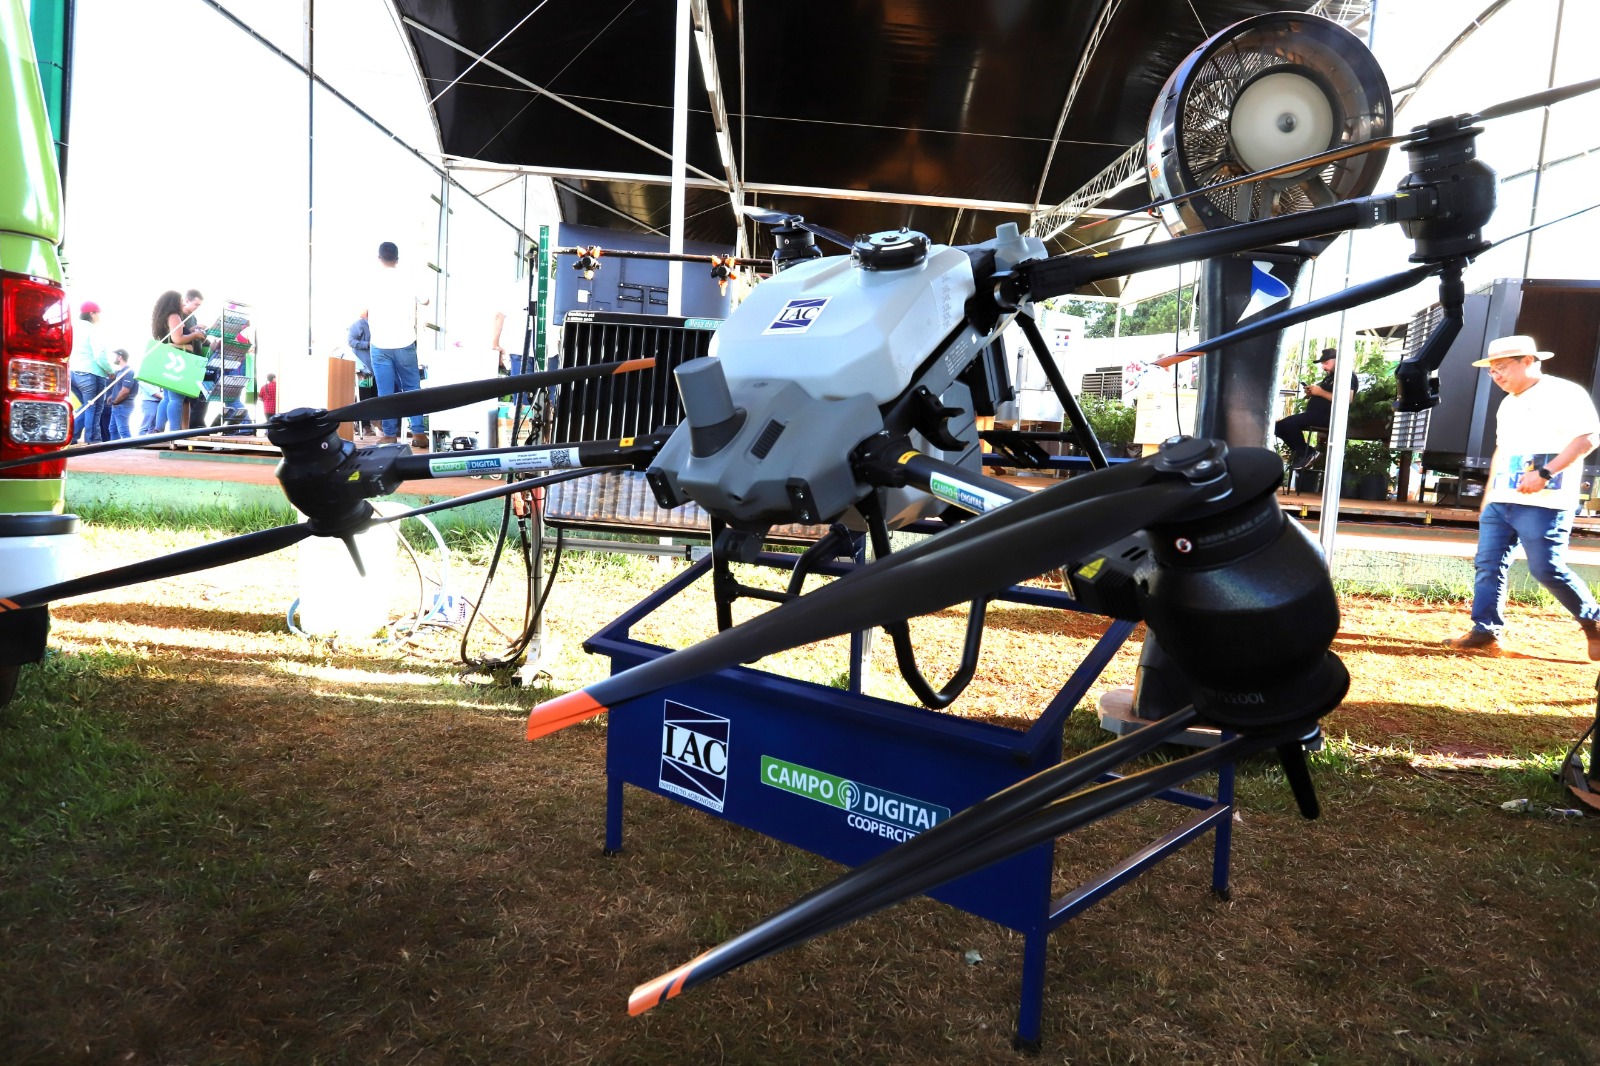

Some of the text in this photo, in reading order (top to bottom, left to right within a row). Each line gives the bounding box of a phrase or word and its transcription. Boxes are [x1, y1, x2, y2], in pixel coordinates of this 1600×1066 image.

[778, 306, 821, 321] IAC
[434, 462, 461, 472] CAMPO
[471, 459, 499, 468] DIGITAL
[933, 481, 984, 509] CAMPO DIGITAL
[662, 723, 728, 776] IAC
[767, 764, 834, 799] CAMPO
[847, 813, 917, 843] COOPERCIT
